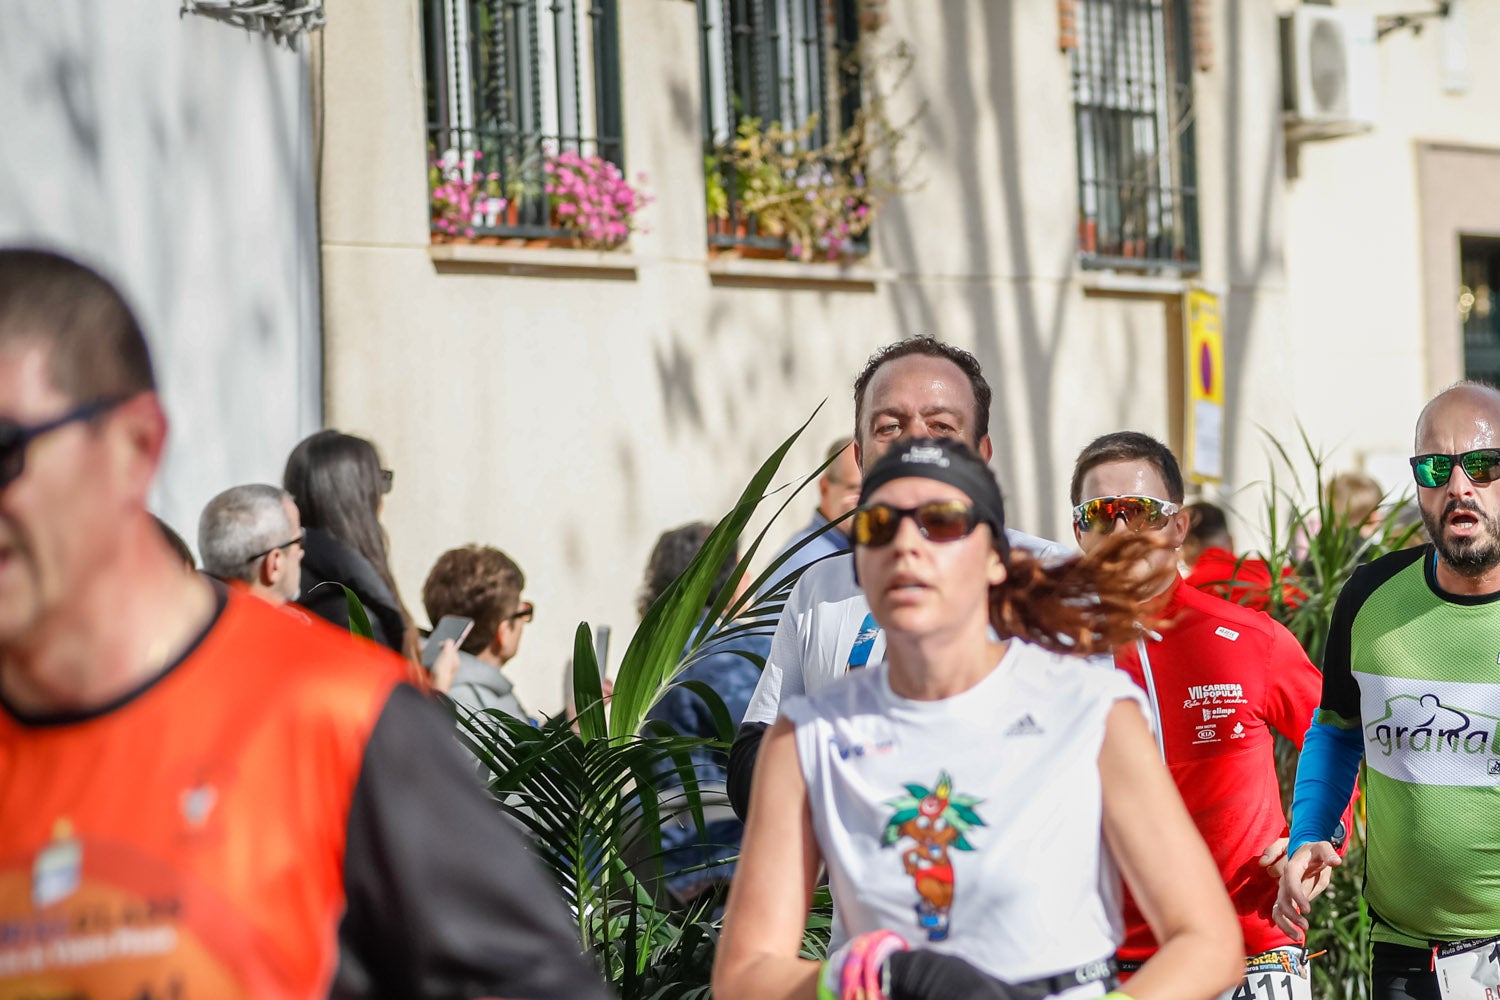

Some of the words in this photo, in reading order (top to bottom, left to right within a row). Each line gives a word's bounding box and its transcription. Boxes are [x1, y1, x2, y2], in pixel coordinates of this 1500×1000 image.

[1202, 683, 1243, 691] CARRERA
[1188, 686, 1203, 700] VII
[1203, 690, 1244, 698] POPULAR
[1212, 707, 1236, 715] olimpo
